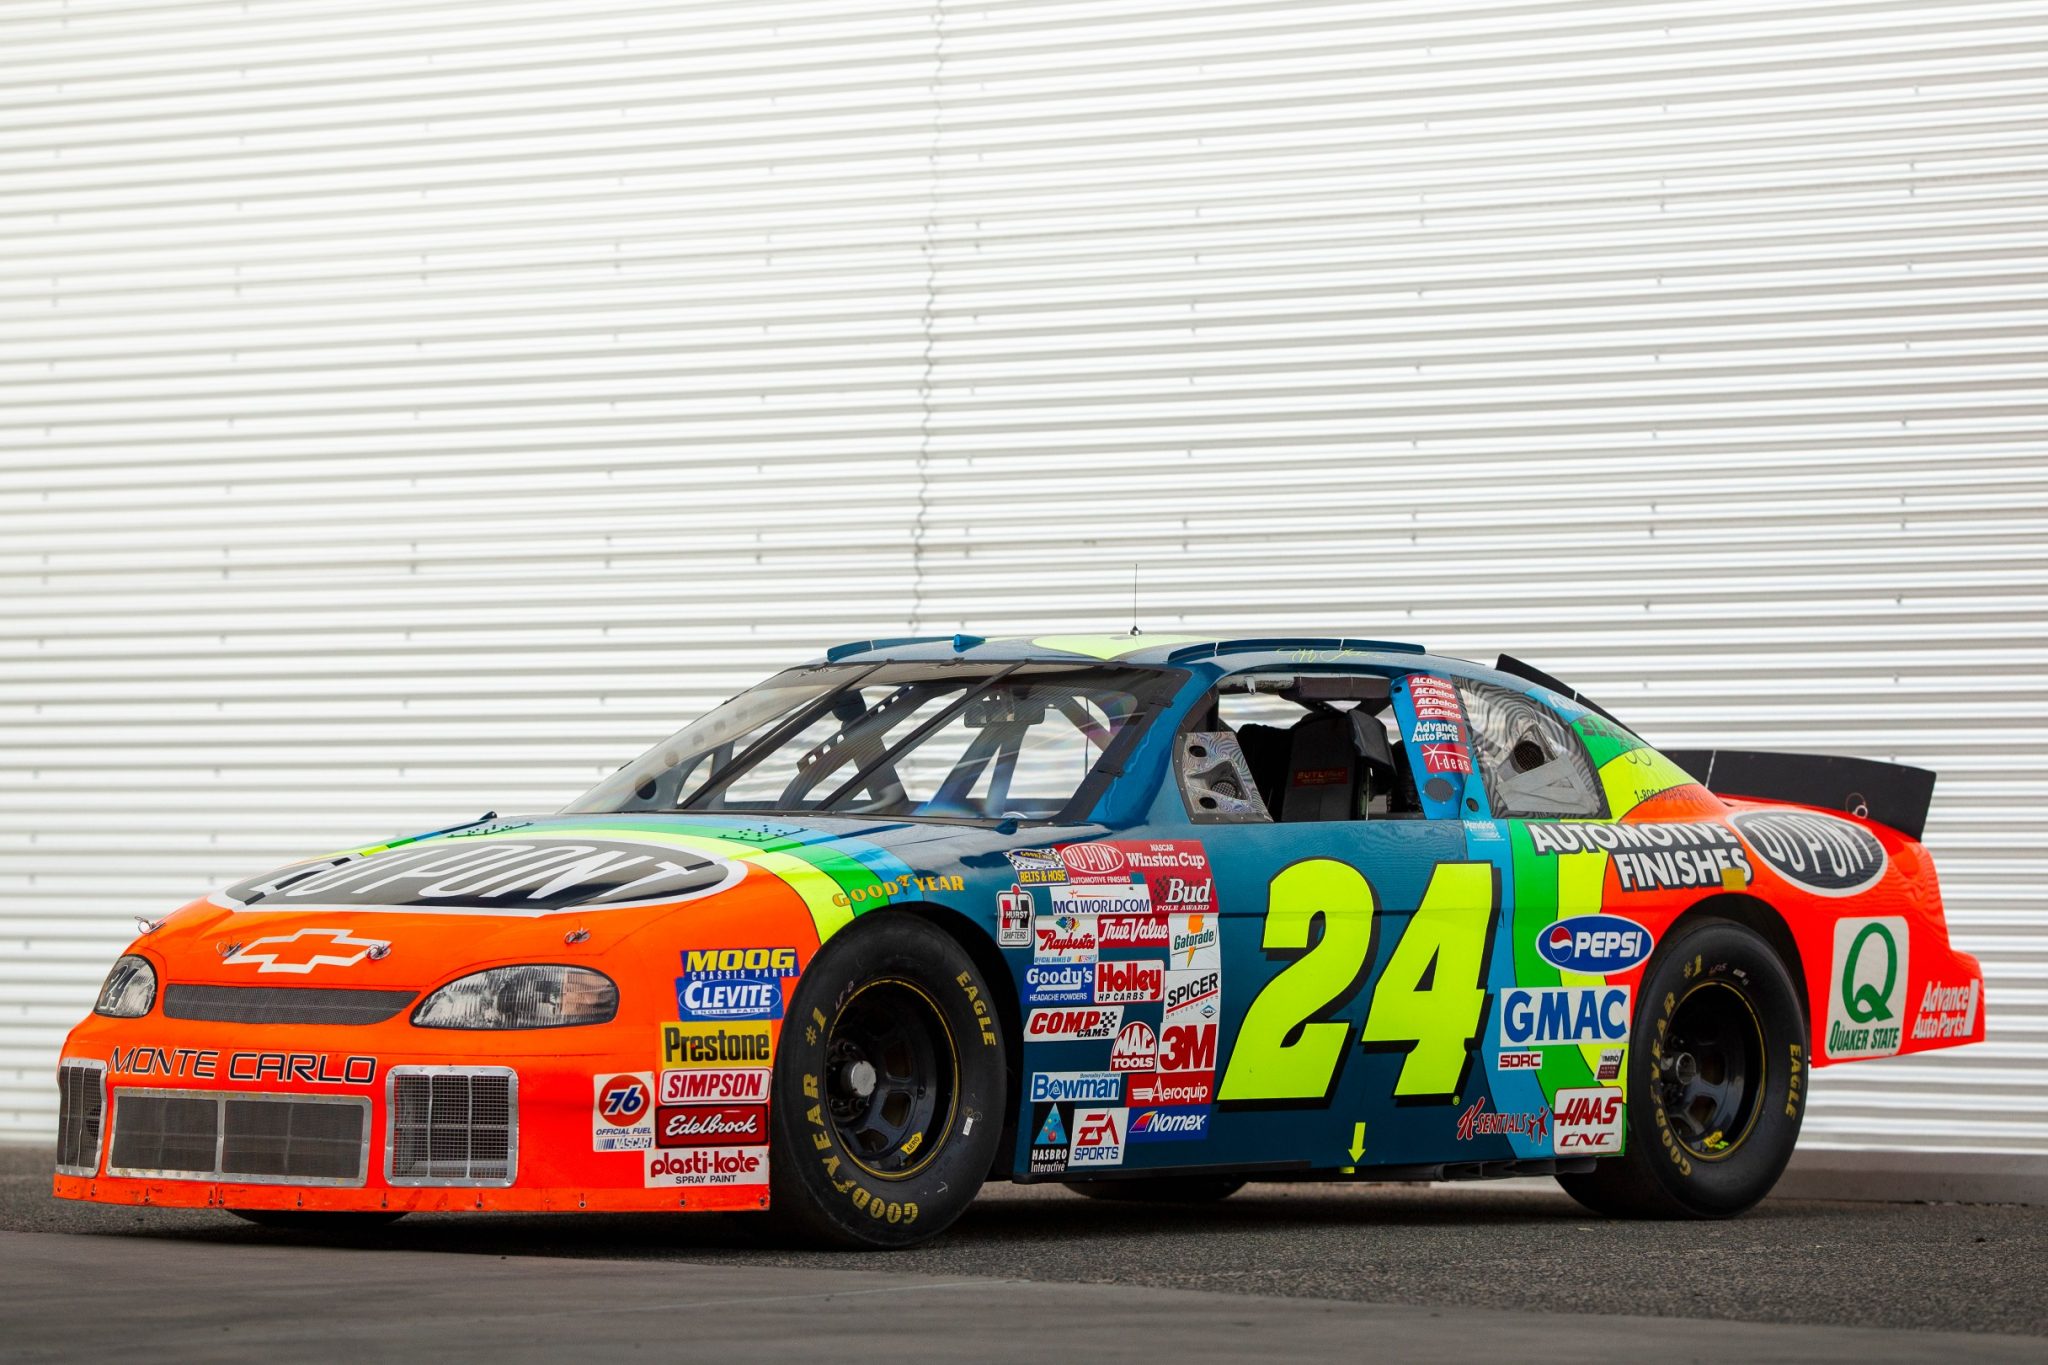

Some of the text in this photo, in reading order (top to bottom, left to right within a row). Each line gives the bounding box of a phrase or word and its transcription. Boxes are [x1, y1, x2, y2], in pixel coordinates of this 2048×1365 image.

[1412, 677, 1452, 689] ACDelco
[1415, 687, 1455, 699] ACDelco
[1417, 697, 1458, 709] ACDelco
[1420, 708, 1462, 719] ACDelco
[1412, 732, 1459, 743] Auto Parts
[1416, 721, 1458, 734] Advance
[1150, 844, 1174, 852] NASCAR
[1529, 822, 1737, 853] AUTOMOTIVE
[1126, 852, 1206, 870] Winston Cup
[1614, 848, 1752, 889] FINISHES
[1020, 869, 1066, 883] BELTS & HOSE
[1165, 878, 1213, 904] Bud
[1005, 910, 1029, 919] HURST
[1003, 931, 1027, 940] SHIFTERS
[1036, 929, 1096, 956] Raybestos
[1173, 929, 1215, 951] Gatorade
[1574, 931, 1643, 958] PEPSI
[685, 948, 796, 972] MOOG
[691, 968, 794, 981] CHASSIS PARTS
[1026, 966, 1093, 989] Goody's
[1098, 962, 1161, 1000] Holley
[1216, 857, 1496, 1104] 24
[1842, 922, 1898, 1024] Q
[684, 981, 773, 1009] CLEVITE
[1029, 992, 1088, 1001] HEADACHE POWDERS
[1098, 992, 1145, 1001] HP CARBS
[1167, 972, 1219, 1007] SPICER
[1920, 980, 1970, 1012] Advance
[957, 970, 997, 1047] EAGLE
[1503, 989, 1628, 1043] GMAC
[805, 1007, 827, 1046] #1
[1030, 1011, 1101, 1035] COMP
[1076, 1028, 1110, 1038] CAMS
[1910, 1012, 1965, 1040] Auto Parts
[664, 1027, 770, 1062] Prestone
[1113, 1024, 1153, 1056] MAC
[1159, 1023, 1218, 1071] 3M
[1829, 1020, 1900, 1054] QUAKER STATE
[108, 1045, 377, 1085] MONTE CARLO
[1113, 1057, 1154, 1068] TOOLS
[1500, 1053, 1541, 1068] SDRC
[667, 1073, 763, 1099] SIMPSON
[1150, 1075, 1209, 1103] Aeroquip
[1785, 1043, 1803, 1121] EAGLE
[603, 1085, 643, 1117] 76
[1554, 1096, 1624, 1126] HAAS
[596, 1128, 630, 1136] OFFICIAL
[665, 1113, 759, 1137] Edelbrock
[1076, 1113, 1120, 1146] EA
[1148, 1112, 1207, 1133] Nomex
[612, 1137, 653, 1149] NASCAR
[905, 1135, 920, 1153] AERO
[1560, 1132, 1615, 1148] CNC
[651, 1150, 760, 1178] plasti-kote
[1031, 1148, 1068, 1161] HASBRO
[1073, 1146, 1119, 1161] SPORTS
[1030, 1160, 1066, 1173] Interactive
[675, 1175, 737, 1185] SPRAY PAINT
